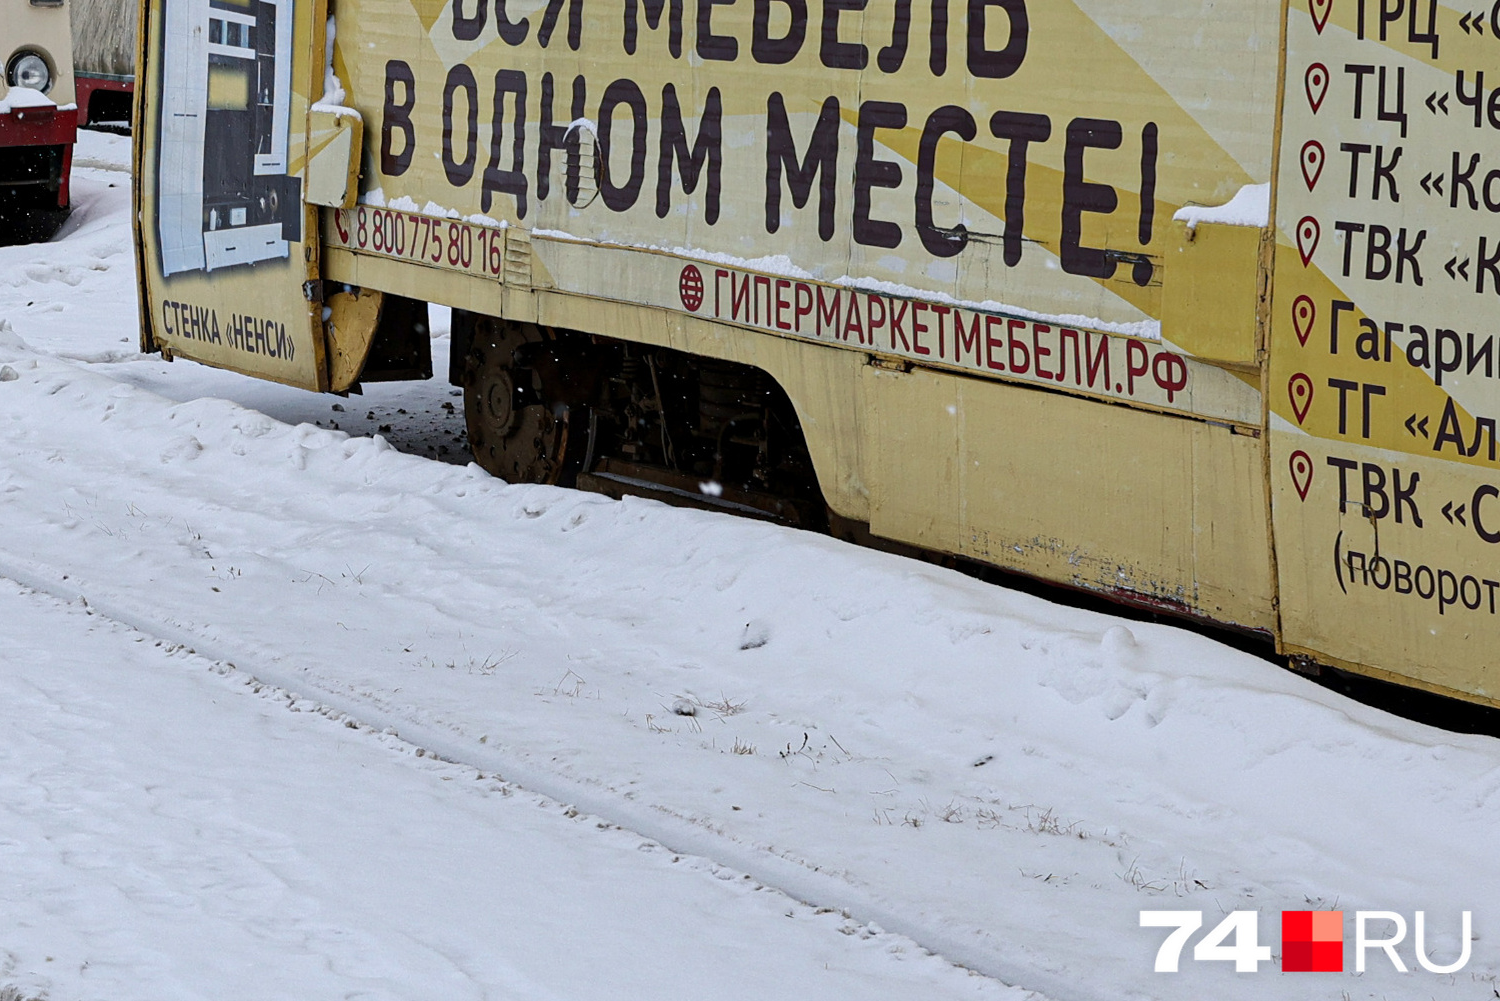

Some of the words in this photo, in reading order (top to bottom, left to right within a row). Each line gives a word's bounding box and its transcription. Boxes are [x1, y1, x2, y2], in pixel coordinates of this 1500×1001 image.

[1344, 63, 1407, 138] ТЦ
[380, 59, 416, 177] В
[442, 63, 722, 226] ОДНОМ
[765, 90, 1160, 288] МЕСТЕ!
[1340, 142, 1403, 202] ТК
[1420, 151, 1500, 213] «Ко
[357, 206, 368, 248] 8
[372, 209, 405, 256] 800
[409, 215, 442, 263] 775
[447, 222, 472, 268] 80
[477, 227, 501, 275] 16
[1335, 221, 1427, 287] ТВК
[1444, 236, 1500, 297] «К
[162, 299, 222, 346] СТЕНКА
[226, 312, 295, 362] «НЕНСИ»
[714, 268, 1188, 403] ГИПЕРМАРКЕТМЕБЕЛИ.РФ
[1330, 299, 1500, 387] Гагари
[1328, 378, 1386, 439] ТГ
[1327, 456, 1423, 529] ТВК
[1441, 484, 1500, 544] «С
[1334, 530, 1500, 615] (поворот
